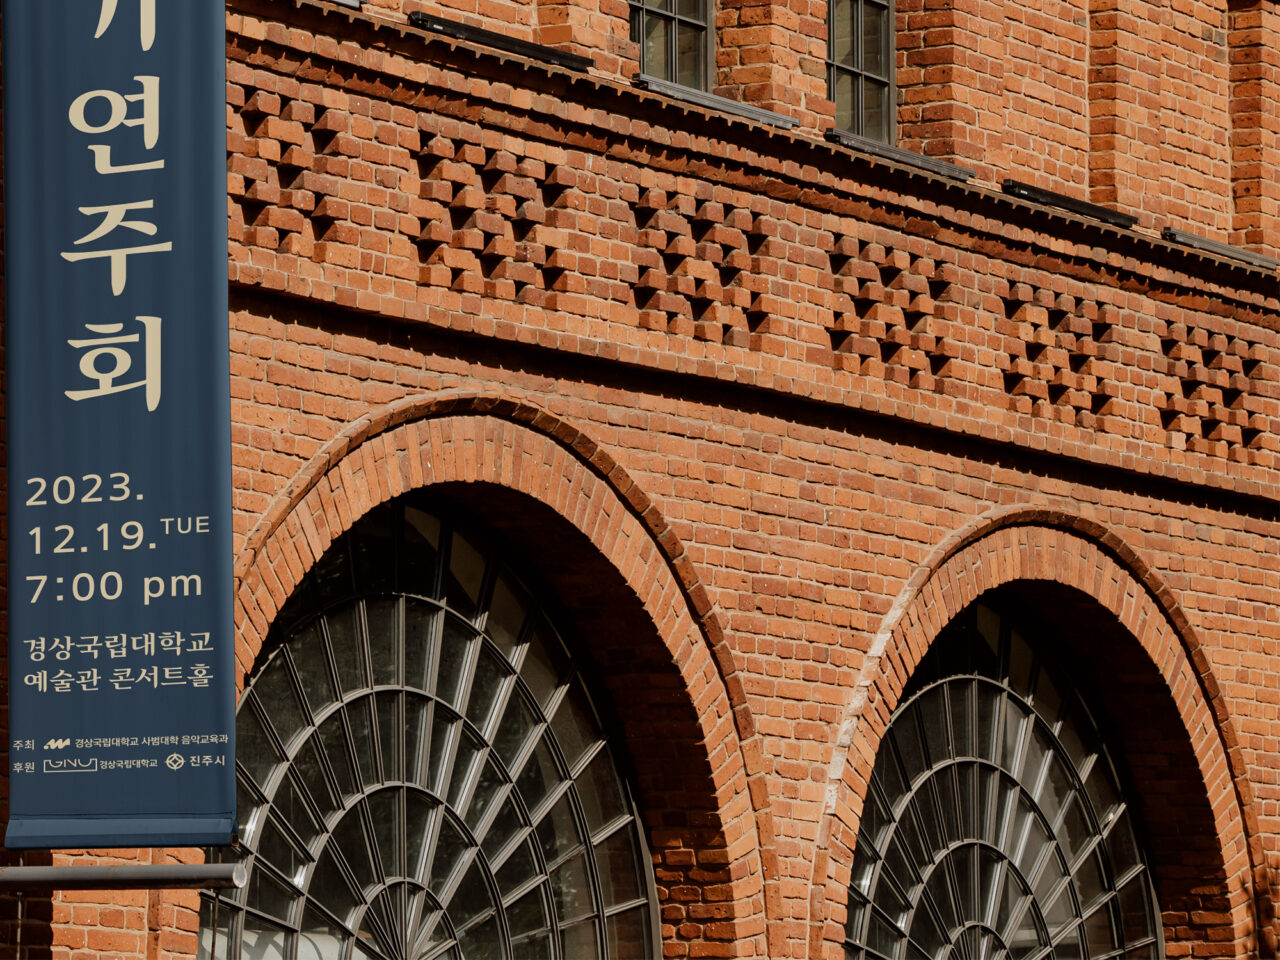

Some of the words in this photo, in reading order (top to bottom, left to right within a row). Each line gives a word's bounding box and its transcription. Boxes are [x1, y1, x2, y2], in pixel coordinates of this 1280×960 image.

[25, 472, 145, 507] 2023.
[28, 520, 157, 555] 12.19.
[159, 515, 210, 535] TUE
[25, 571, 123, 604] 7:00
[143, 573, 202, 606] pm
[23, 630, 214, 662] 경상국립대학교
[23, 667, 102, 694] 예술관
[108, 663, 214, 691] 콘서트홀
[12, 739, 35, 751] 주최
[74, 737, 139, 750] 경상국립대학교
[141, 734, 180, 747] 사범대학
[181, 733, 229, 746] 음악교육과
[12, 761, 35, 774] 후원
[99, 759, 159, 771] 경상국립대학교
[189, 754, 226, 768] 진주시
